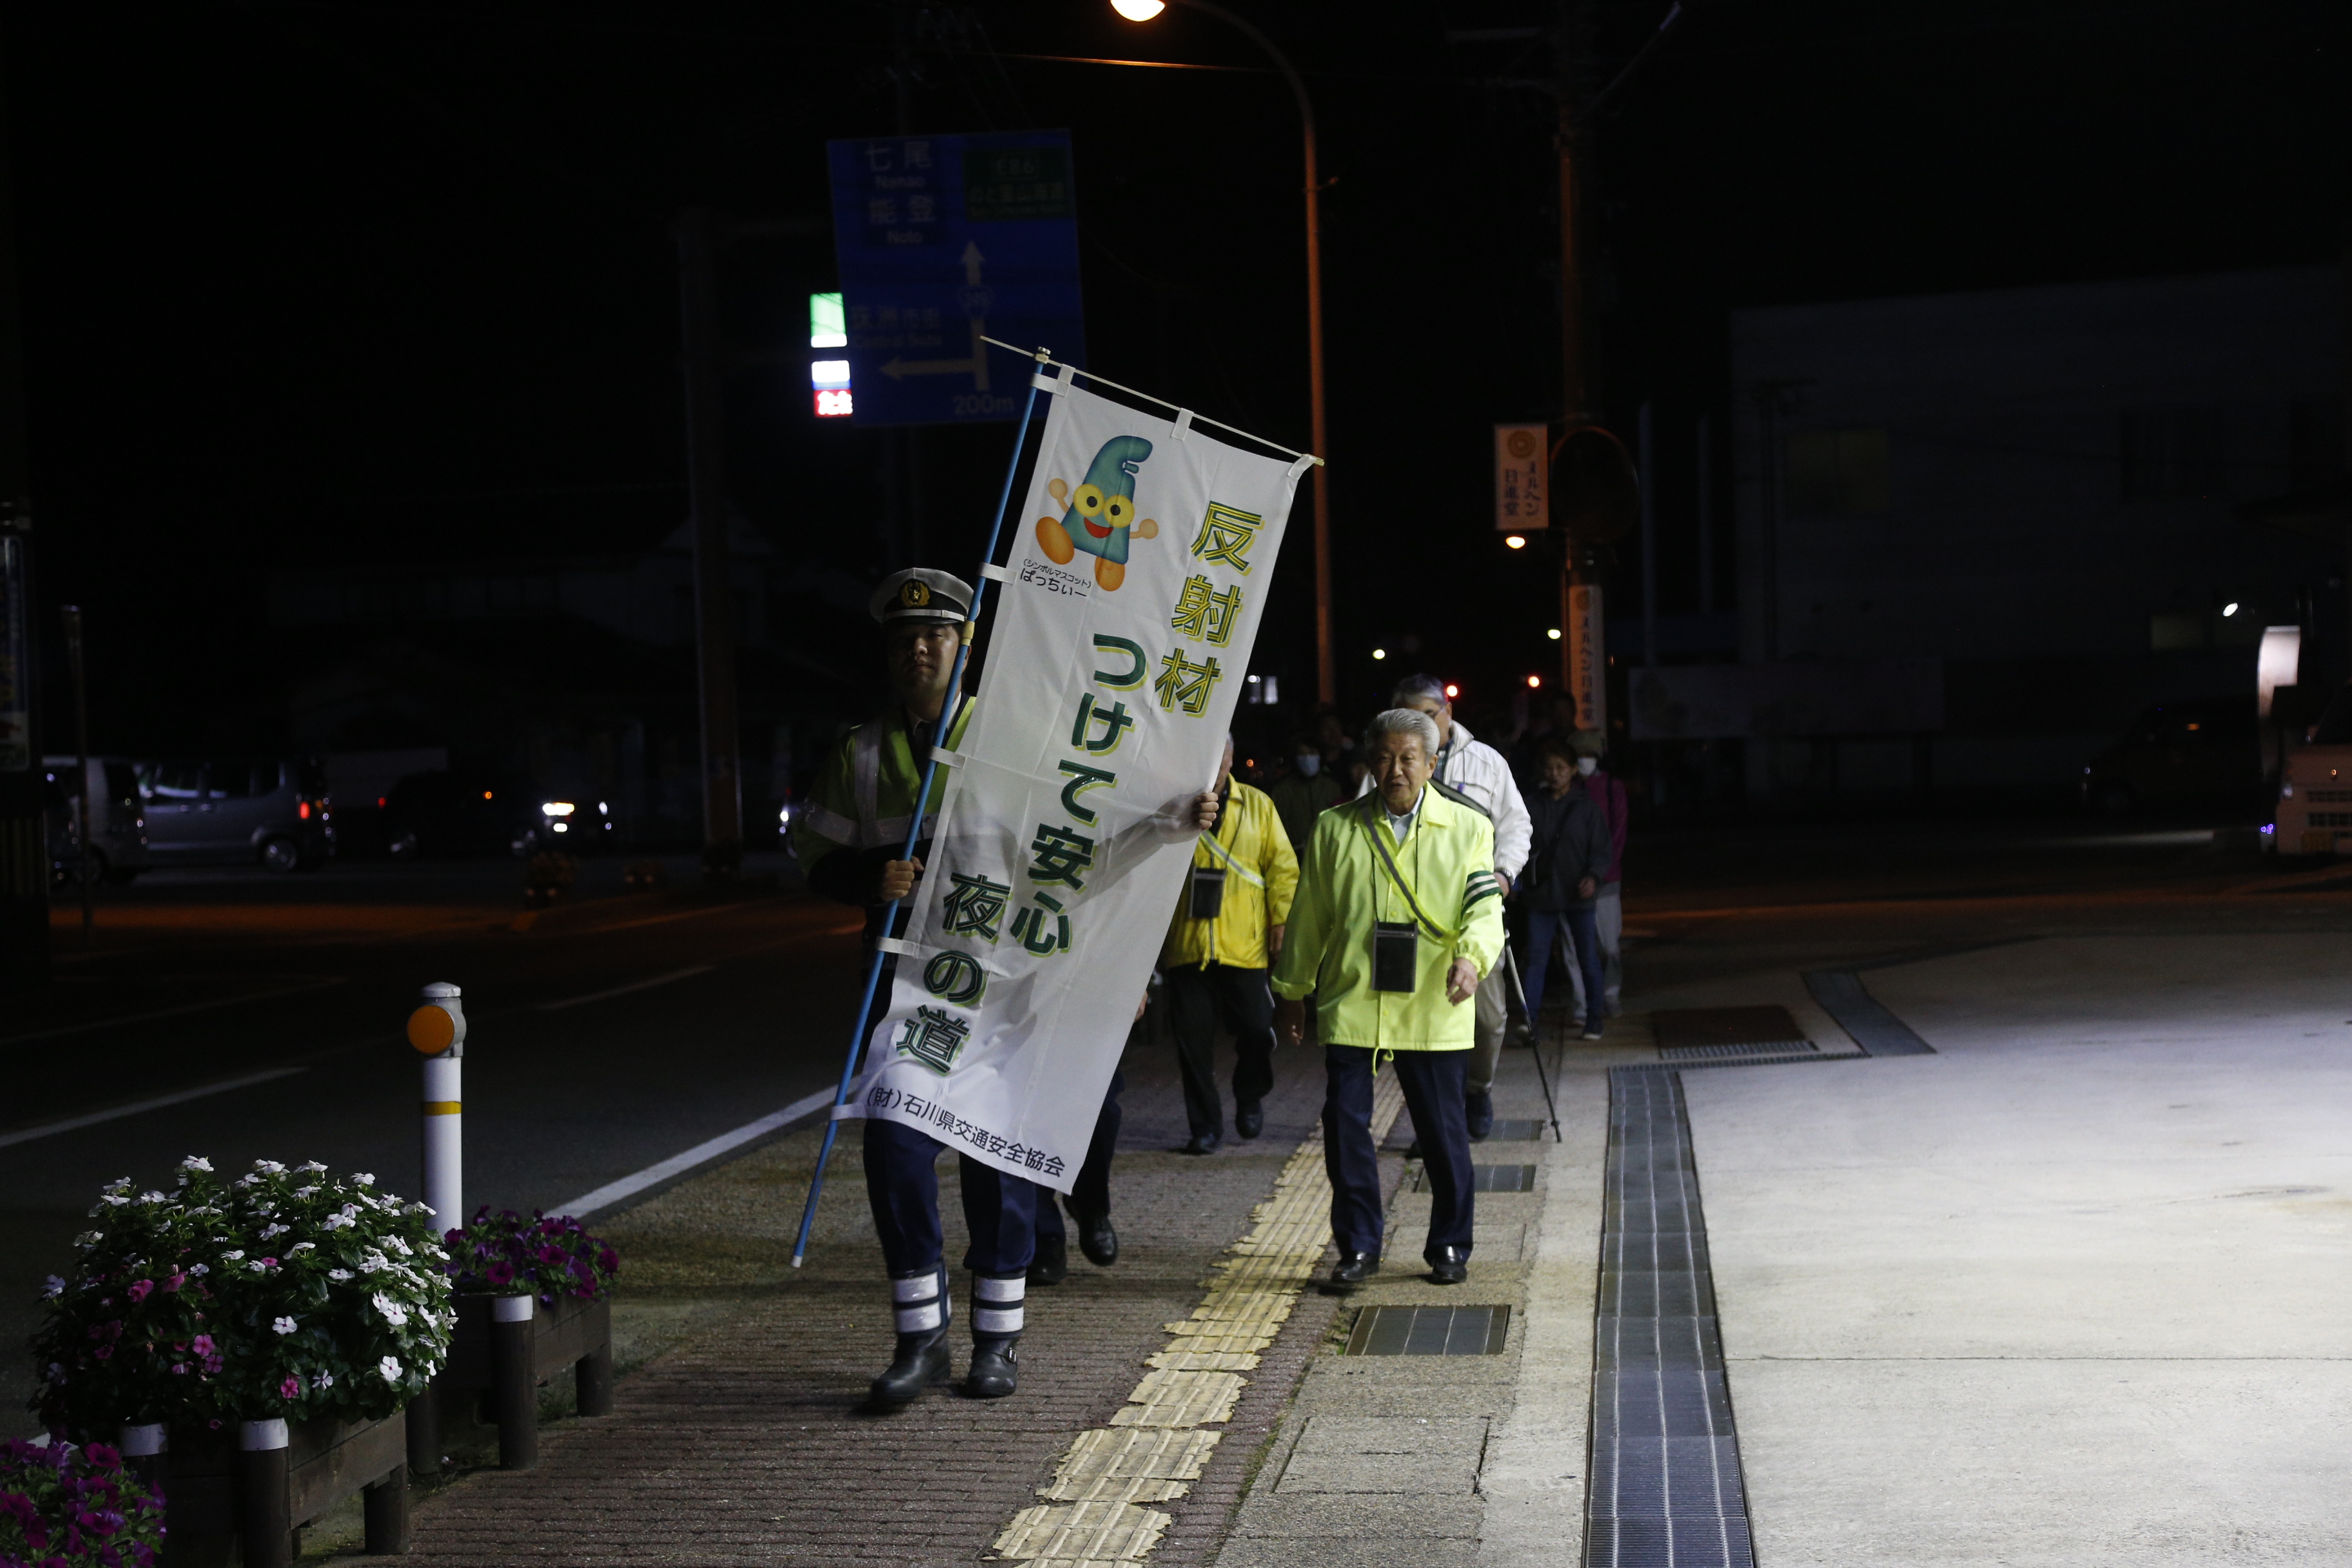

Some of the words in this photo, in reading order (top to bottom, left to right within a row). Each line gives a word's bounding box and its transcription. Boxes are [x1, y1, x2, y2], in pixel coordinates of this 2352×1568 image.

[865, 141, 932, 172] 七尾
[875, 174, 926, 189] Nanao
[868, 195, 936, 226] 能登
[886, 230, 923, 244] Noto
[952, 393, 1015, 415] 200m
[1024, 558, 1092, 588] (シンボルマスコット)
[1155, 500, 1266, 718] 反射材
[1010, 634, 1150, 959] つけて安心
[896, 874, 1013, 1077] 夜の道
[868, 1086, 1066, 1177] (財)石川県交通安全協会
